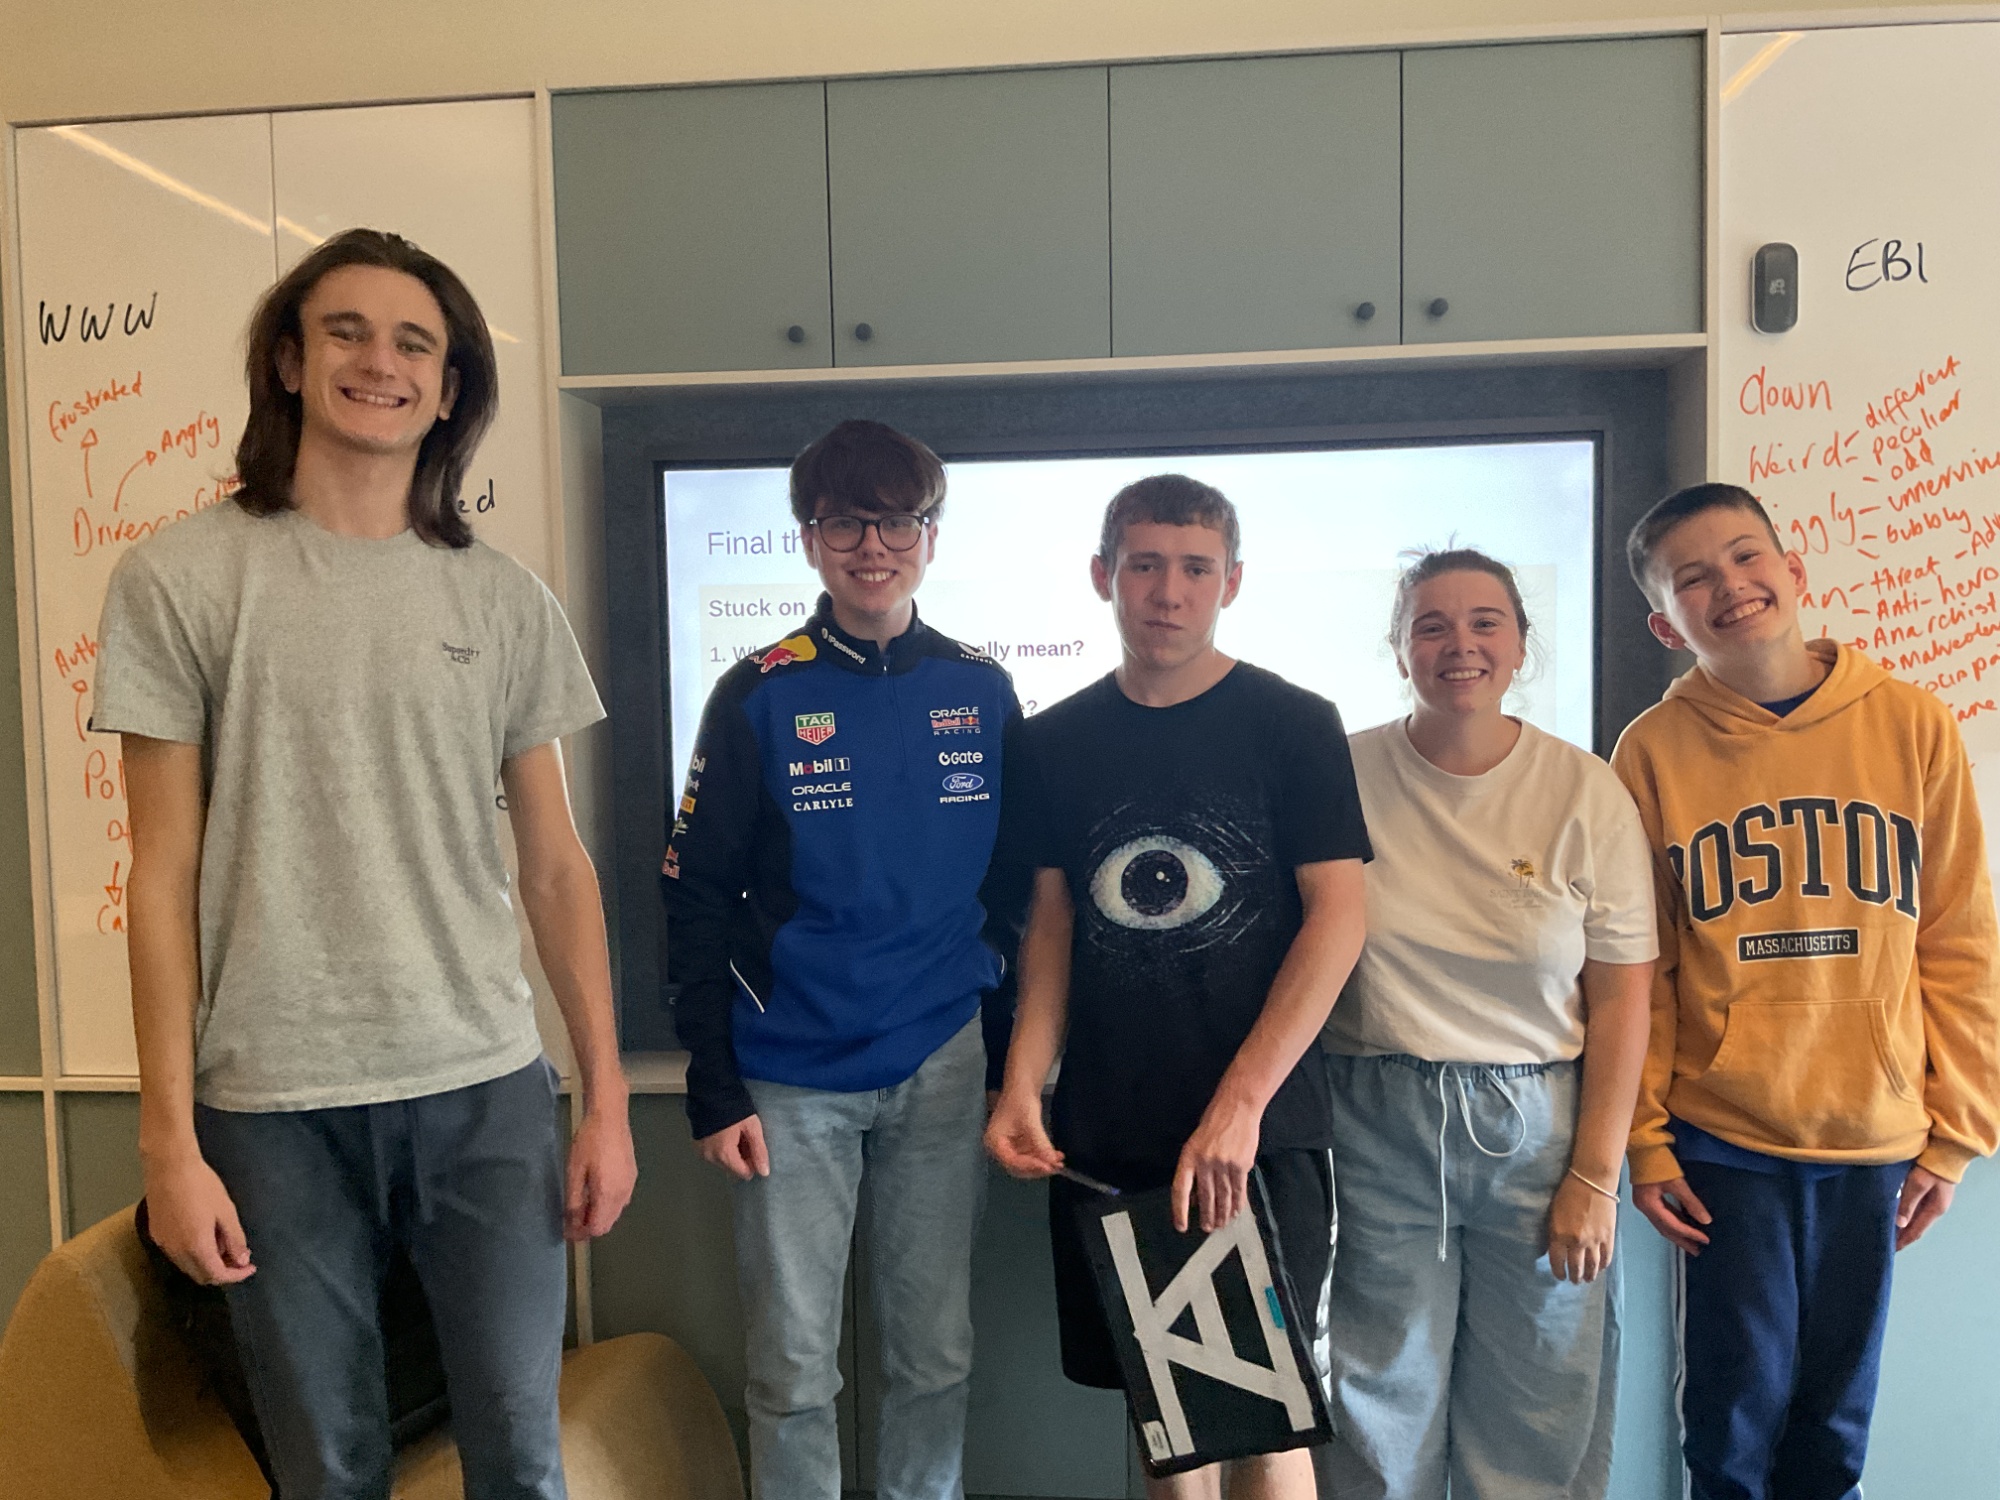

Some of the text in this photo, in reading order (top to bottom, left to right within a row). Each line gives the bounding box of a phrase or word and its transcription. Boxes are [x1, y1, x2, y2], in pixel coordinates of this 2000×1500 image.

[161, 410, 220, 459] Angry
[708, 529, 772, 556] Final
[1870, 555, 1940, 596] threat
[708, 598, 807, 618] Stuck on
[1017, 639, 1085, 658] mean?
[799, 714, 832, 727] TAG
[929, 706, 979, 719] ORACLE
[799, 725, 834, 743] HEUER
[933, 727, 981, 736] RACING
[789, 758, 833, 777] Mobil
[791, 781, 852, 796] ORACLE
[948, 775, 974, 790] Ford
[793, 797, 854, 812] CARLYLE
[939, 792, 990, 804] RACING
[1745, 933, 1851, 956] MASSACHUSETTS
